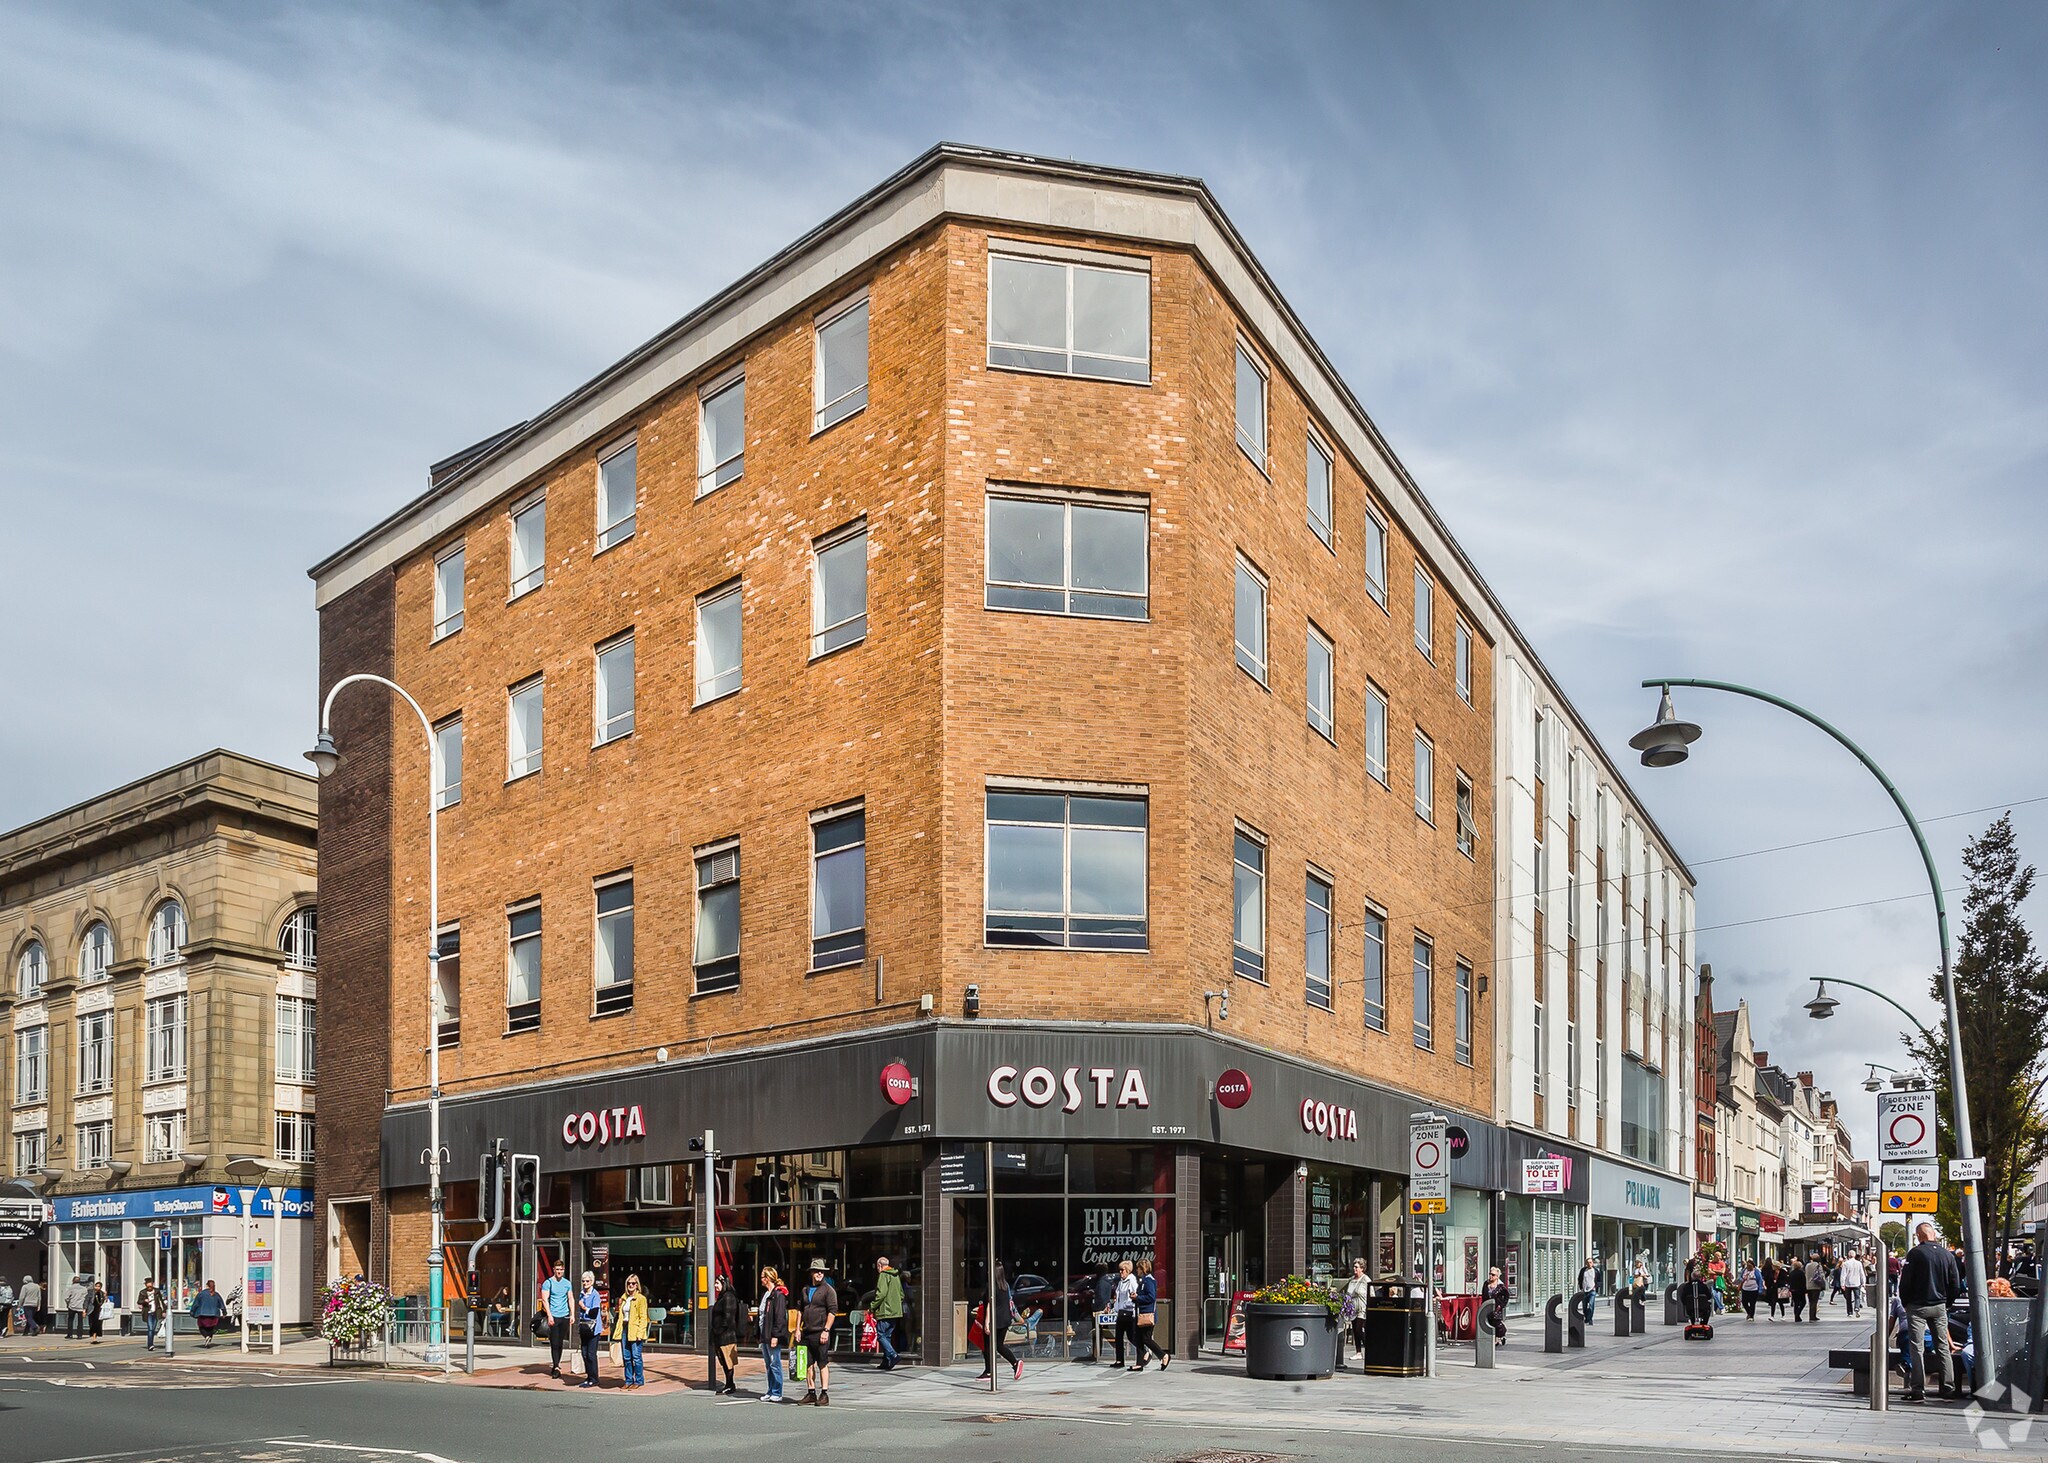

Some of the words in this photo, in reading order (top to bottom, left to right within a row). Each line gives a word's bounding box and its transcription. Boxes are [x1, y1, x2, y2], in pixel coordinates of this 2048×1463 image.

[888, 1078, 910, 1089] COSTA
[988, 1066, 1149, 1112] COSTA
[1219, 1084, 1245, 1093] COSTA
[1882, 1094, 1931, 1103] PEDESTRIAN
[1890, 1102, 1924, 1112] ZONE
[563, 1105, 646, 1144] COSTA
[1300, 1098, 1358, 1140] COSTA
[1626, 1180, 1660, 1209] PRIMARK
[75, 1198, 127, 1218] Entertainer
[154, 1199, 204, 1214] TheToyShop.com
[1084, 1208, 1157, 1235] HELLO
[1084, 1236, 1156, 1246] SOUTHPORT
[1082, 1247, 1120, 1263] Come
[1122, 1252, 1140, 1261] on
[1140, 1246, 1156, 1262] in
